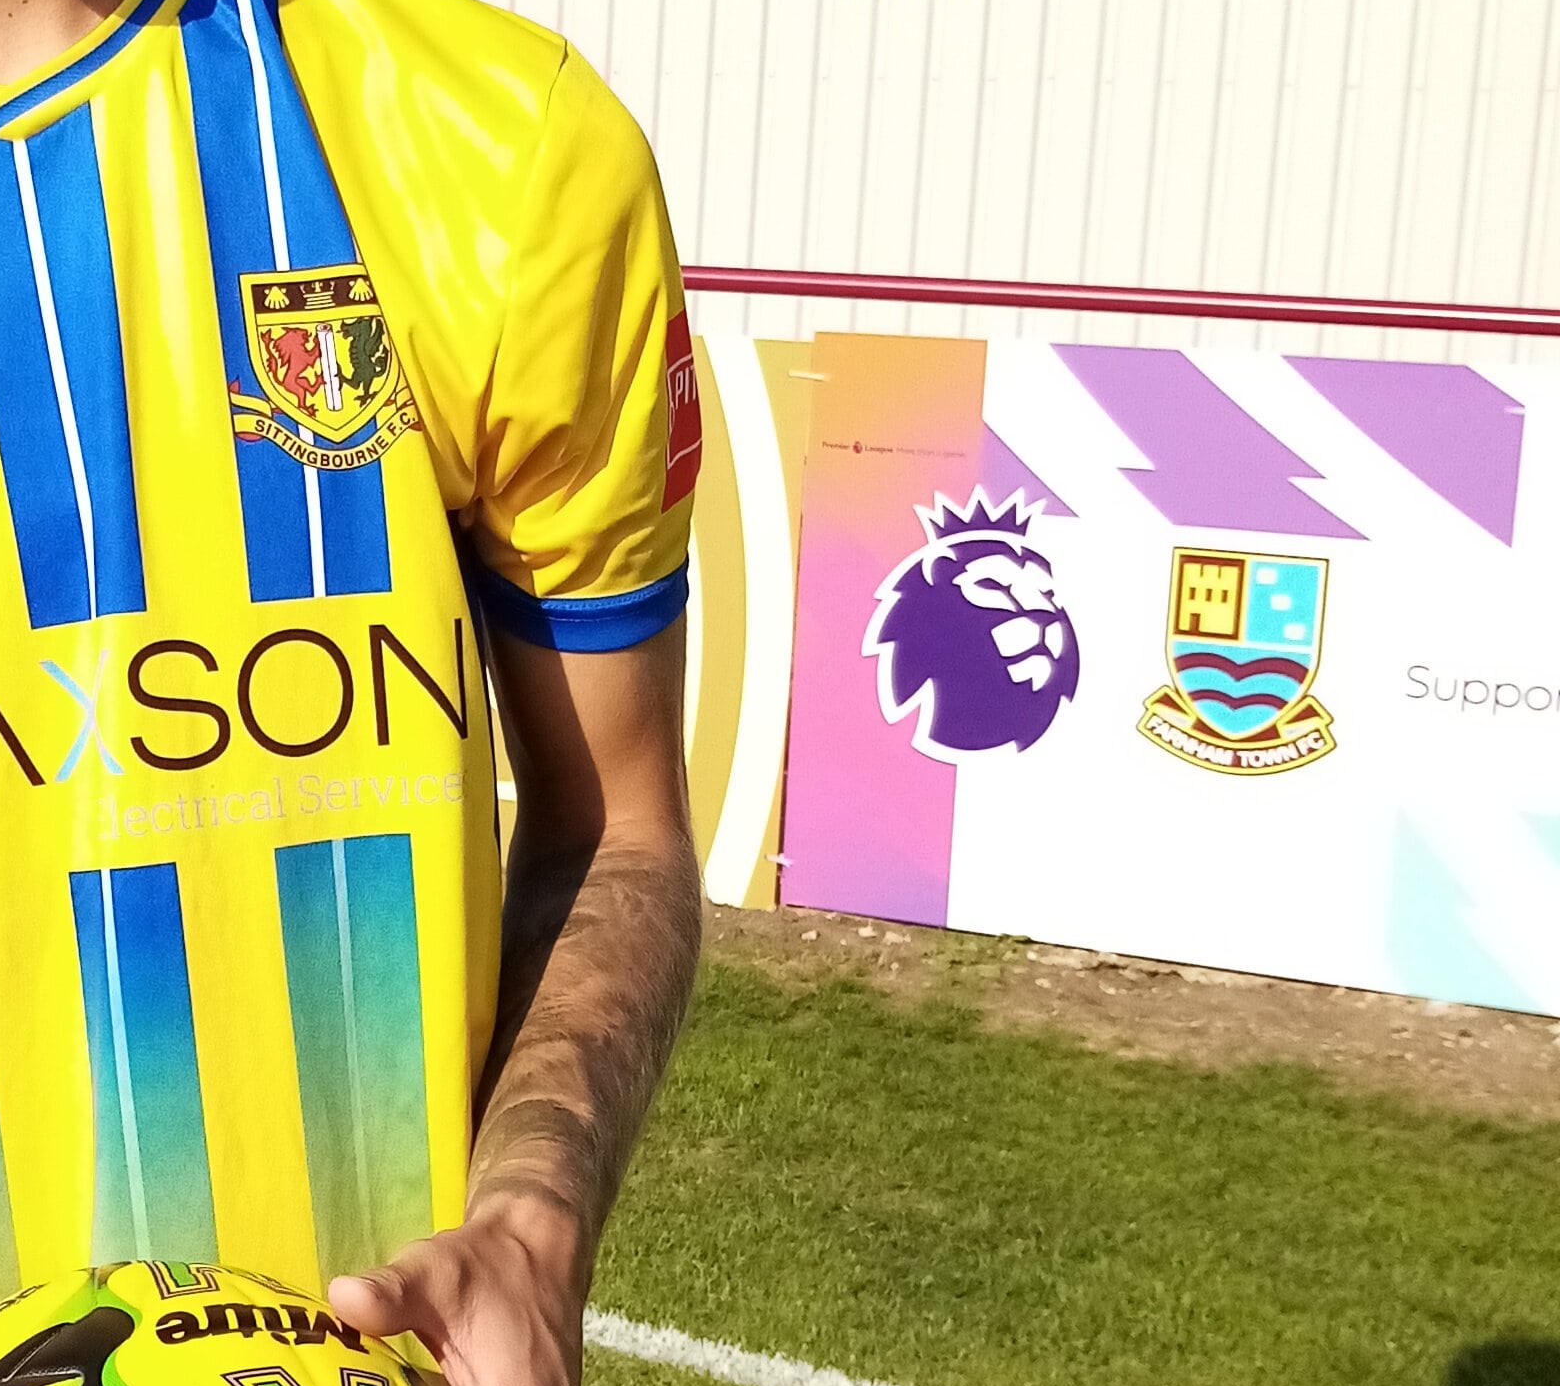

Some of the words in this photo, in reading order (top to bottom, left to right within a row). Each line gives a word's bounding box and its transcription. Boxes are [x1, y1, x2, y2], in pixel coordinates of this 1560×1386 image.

[255, 419, 389, 469] SITTINGBOURNE
[389, 412, 417, 437] F.C.
[1147, 714, 1234, 766] FARNHAM
[1236, 743, 1299, 768] TOWN
[1295, 731, 1325, 756] FC
